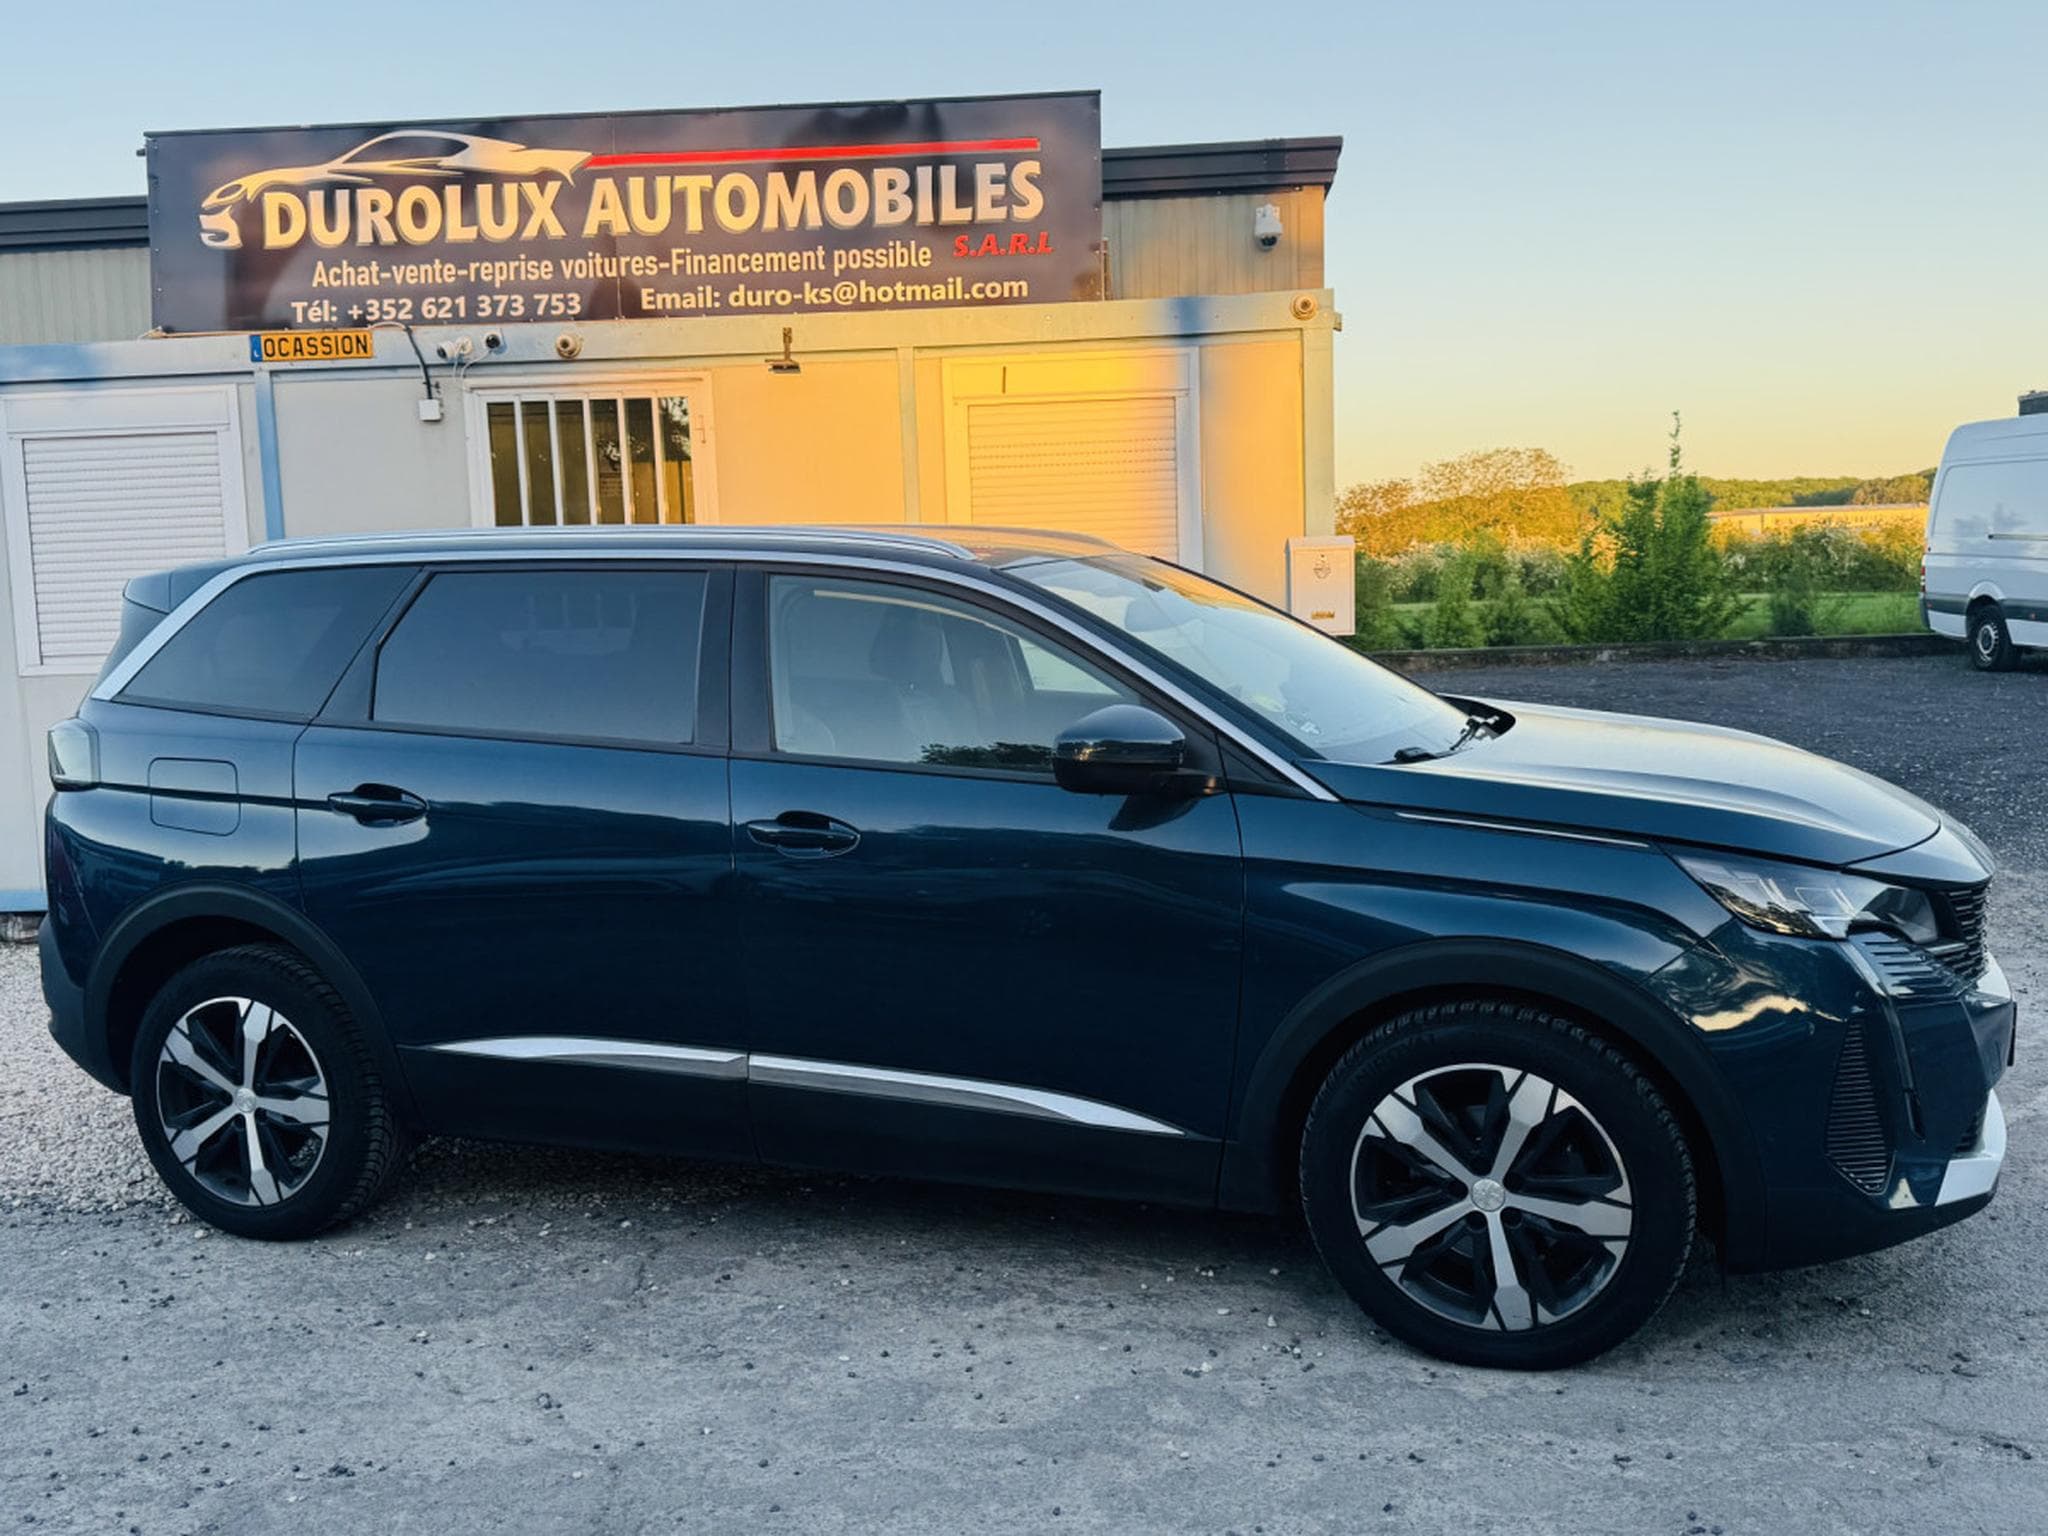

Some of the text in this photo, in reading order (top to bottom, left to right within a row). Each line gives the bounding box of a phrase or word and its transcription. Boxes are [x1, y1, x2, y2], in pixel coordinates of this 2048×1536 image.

[263, 160, 1045, 250] DUROLUX AUTOMOBILES
[953, 231, 1053, 258] S.A.R.L
[312, 239, 932, 290] Achat-vente-reprise voitures-Financement possible
[292, 293, 581, 324] Tél: +352 621 373 753
[641, 277, 1029, 310] Email: duro-ks@hotmail.com
[263, 335, 368, 357] OCASSION
